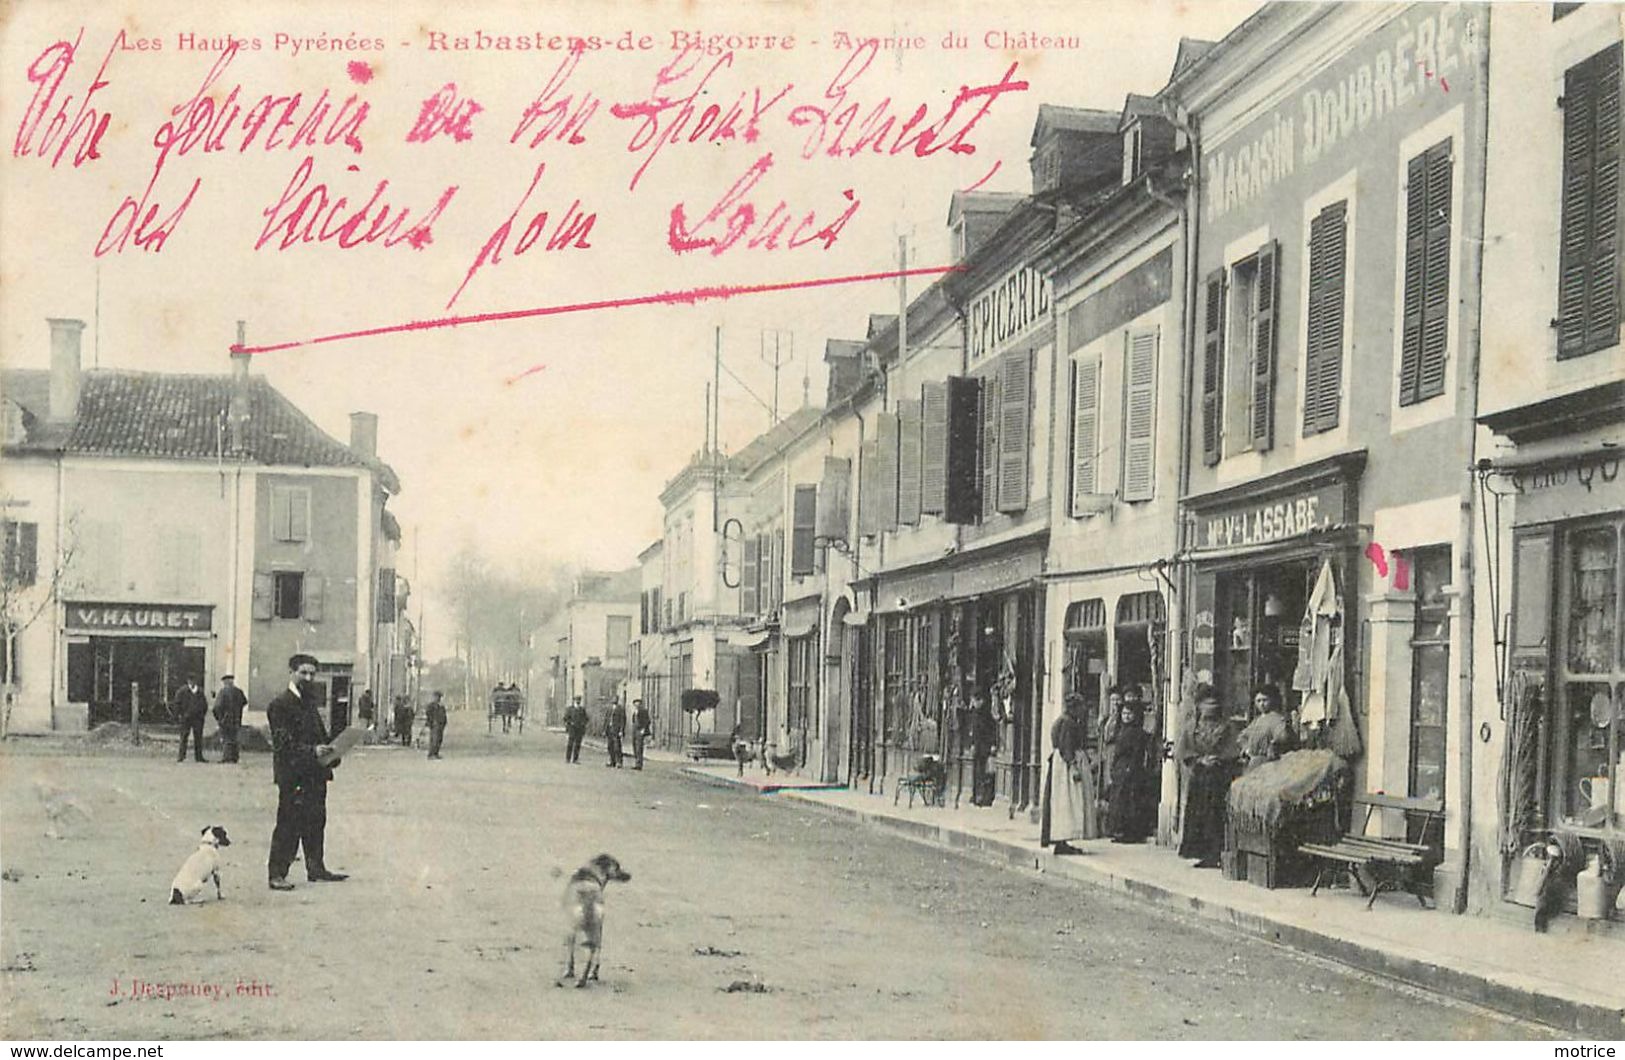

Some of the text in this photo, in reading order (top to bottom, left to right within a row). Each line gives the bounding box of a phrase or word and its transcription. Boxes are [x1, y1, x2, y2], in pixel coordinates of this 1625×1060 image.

[972, 267, 1049, 358] EPICERIE
[78, 609, 200, 627] V. HAURET
